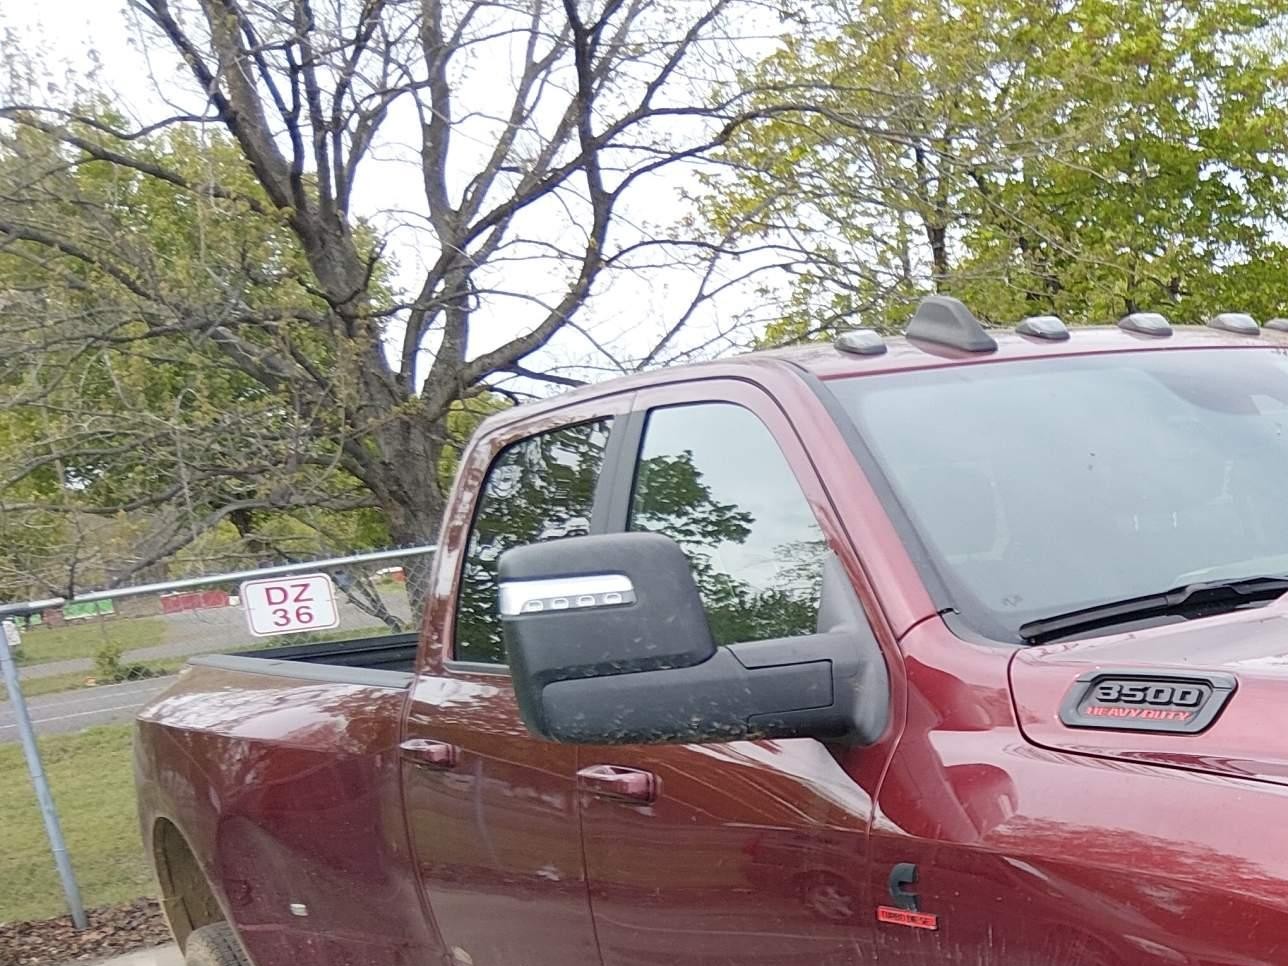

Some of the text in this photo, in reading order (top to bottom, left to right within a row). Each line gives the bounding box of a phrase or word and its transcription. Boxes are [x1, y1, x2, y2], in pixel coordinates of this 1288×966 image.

[264, 583, 314, 606] DZ
[271, 605, 314, 627] 36
[1096, 684, 1204, 707] 3500
